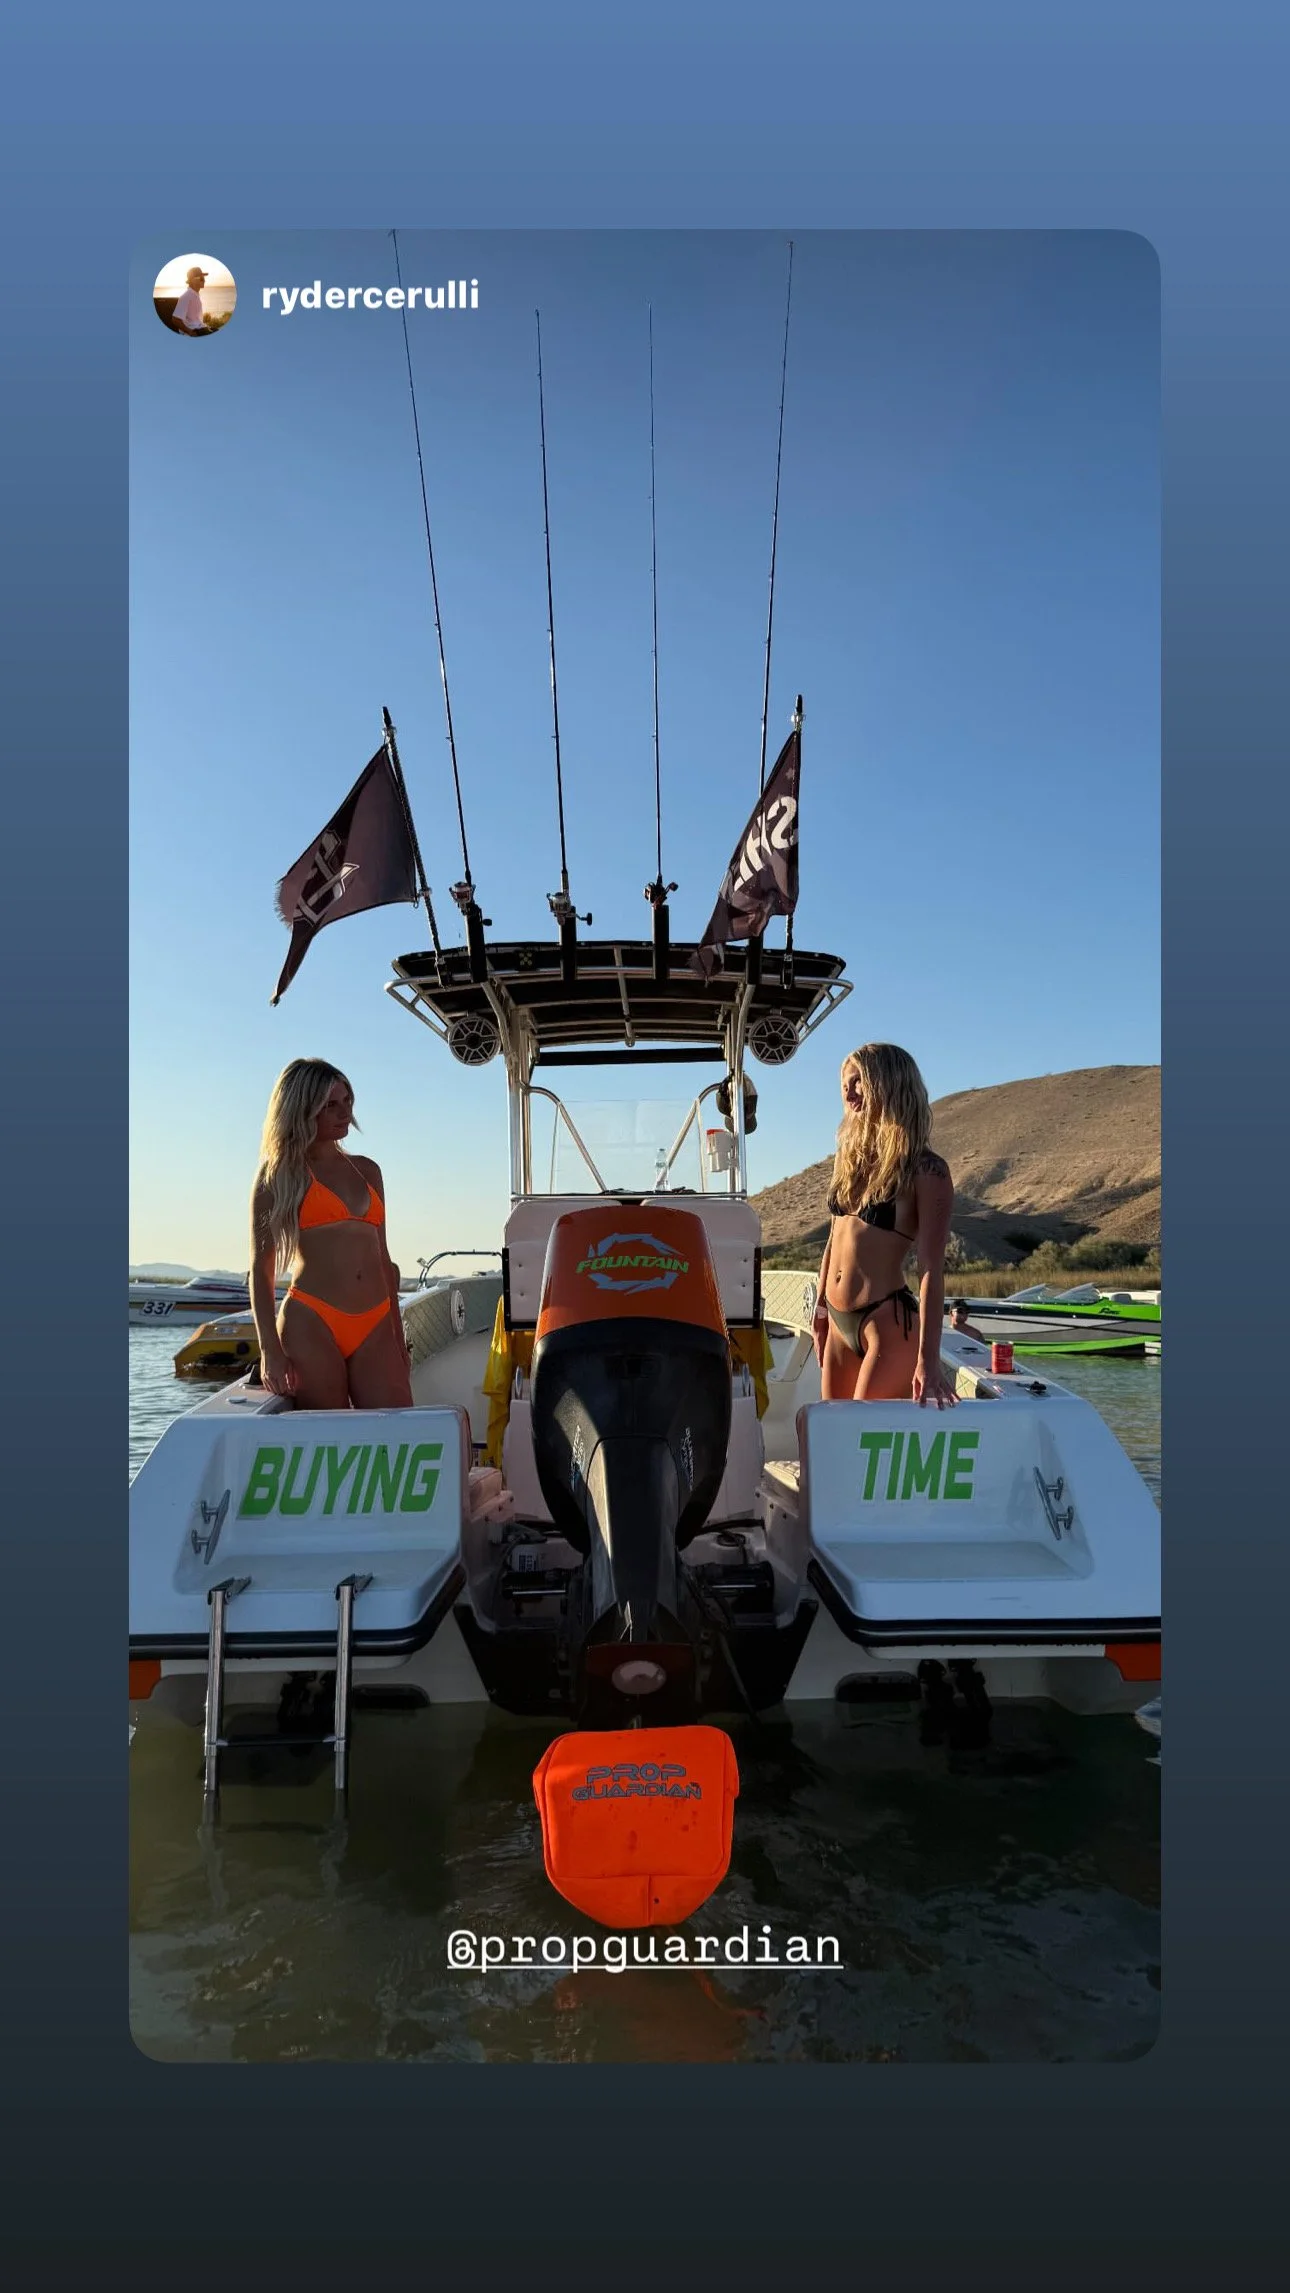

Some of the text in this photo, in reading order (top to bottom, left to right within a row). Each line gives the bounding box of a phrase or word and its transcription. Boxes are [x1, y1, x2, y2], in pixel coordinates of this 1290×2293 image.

[575, 1255, 690, 1274] FOUNTAIN
[143, 1301, 174, 1315] 331
[859, 1431, 981, 1501] TIME
[238, 1442, 444, 1516] BUYING
[586, 1762, 687, 1785] PROP
[571, 1781, 703, 1801] GUARDIAN
